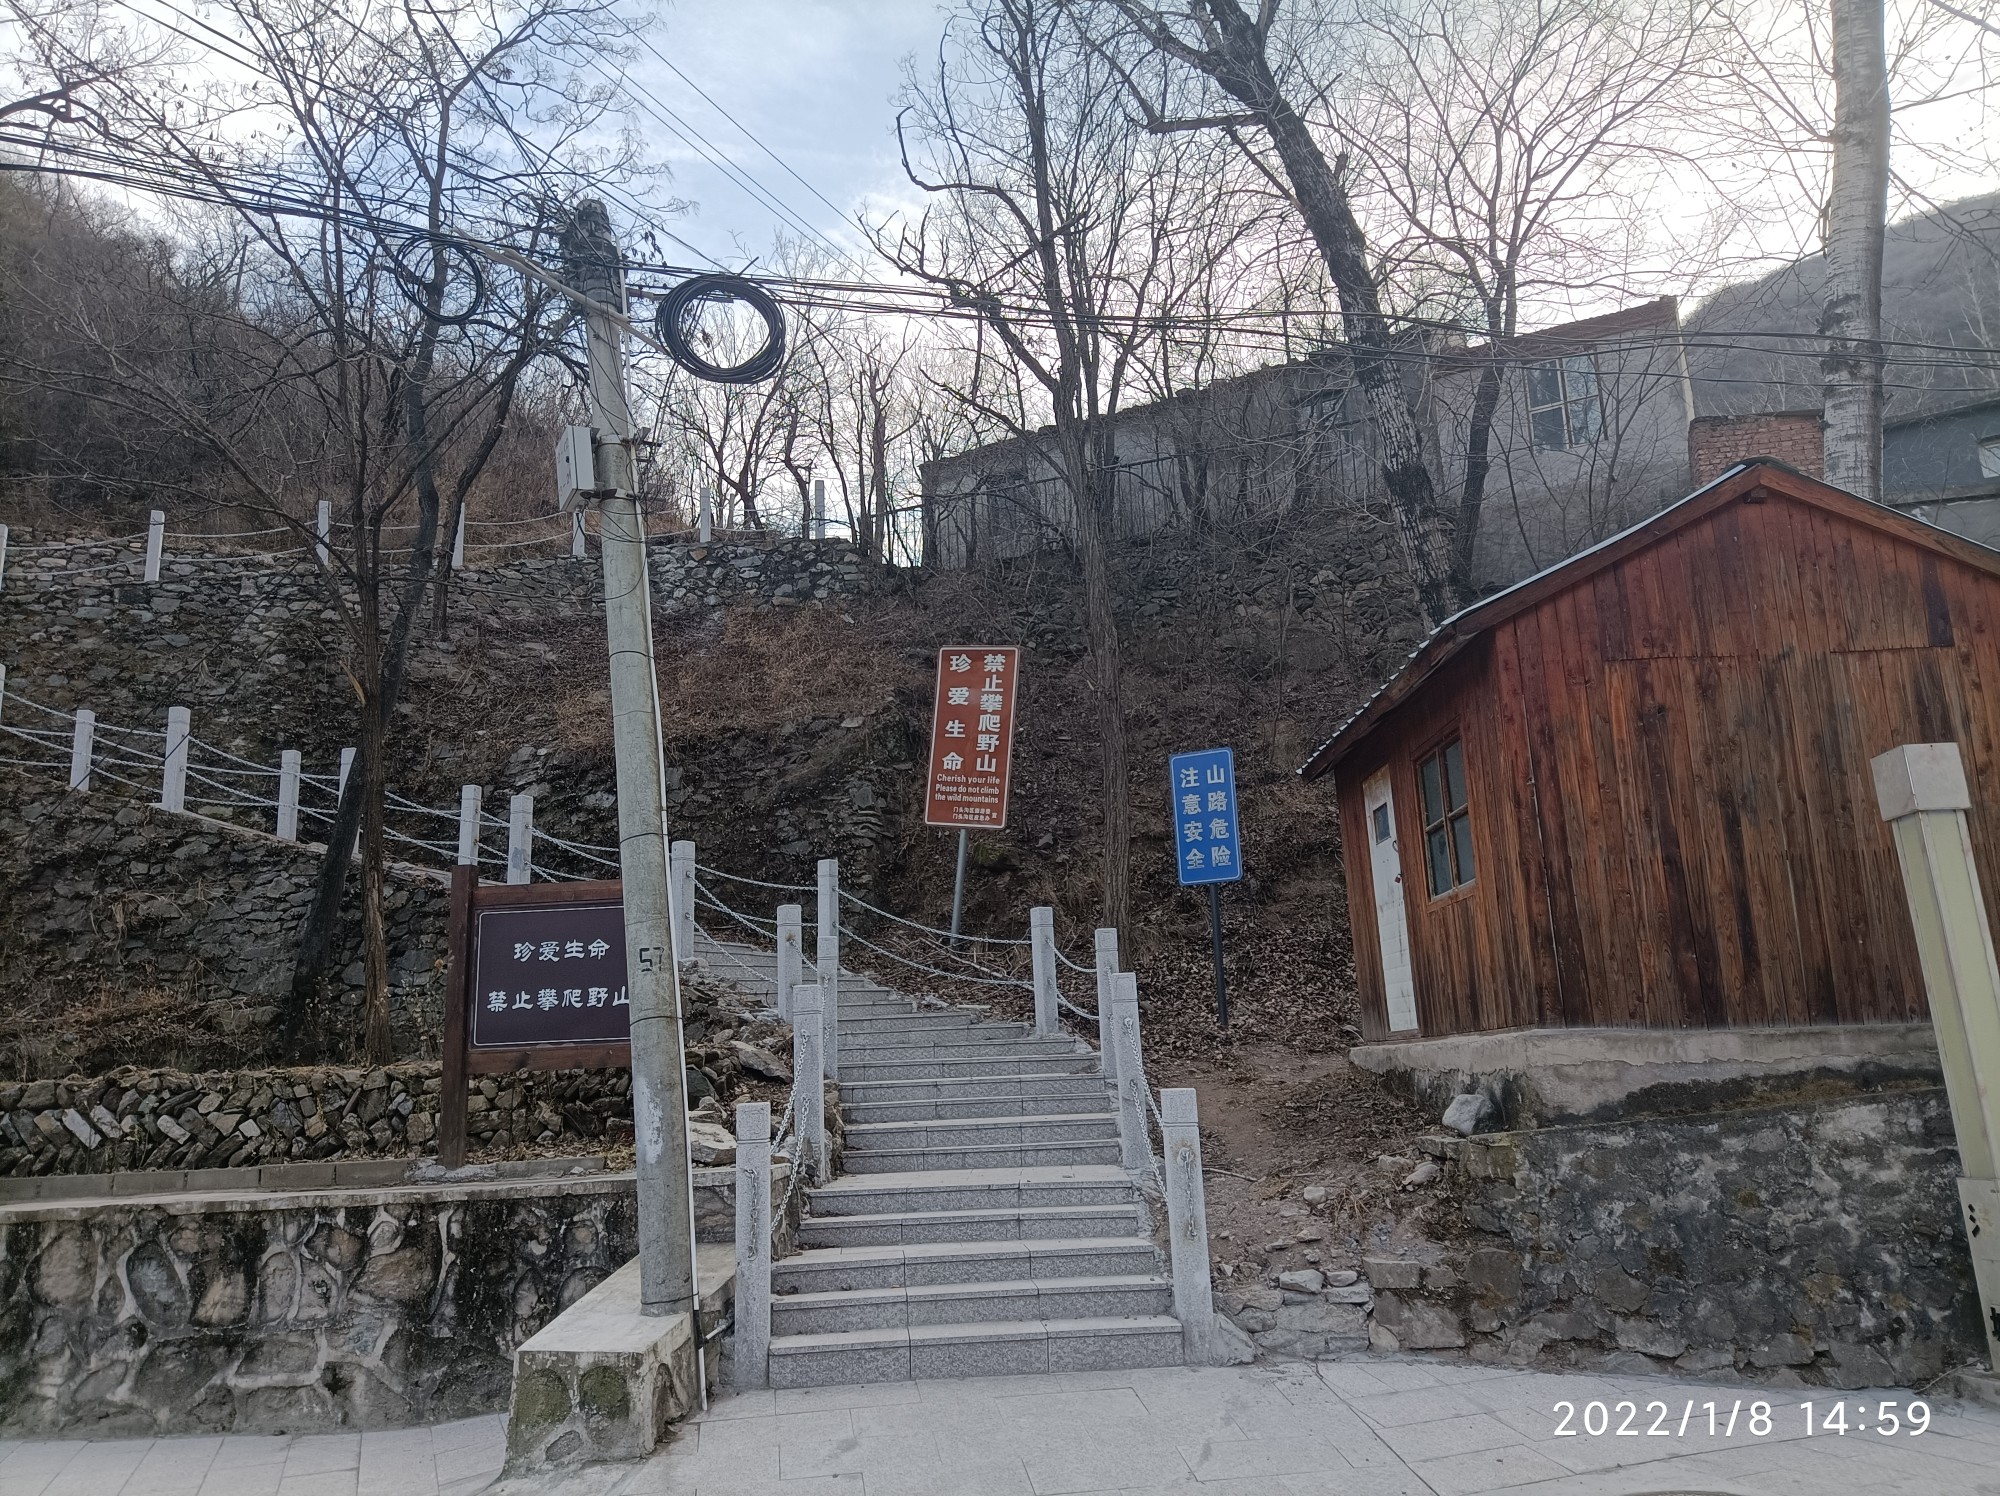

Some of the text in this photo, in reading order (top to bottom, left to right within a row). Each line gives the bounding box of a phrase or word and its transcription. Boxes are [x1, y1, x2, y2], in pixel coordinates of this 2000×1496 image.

[942, 653, 972, 771] 珍爱生命
[976, 653, 1006, 773] 禁止攀爬野山
[935, 783, 957, 792] Please
[958, 785, 967, 793] do
[980, 786, 1000, 795] climb
[937, 773, 1000, 784] Cherish your life
[935, 793, 999, 804] the wild mountains
[1180, 767, 1205, 869] 注意安全
[1207, 764, 1231, 867] 山路危险
[513, 938, 611, 963] 珍爱生命
[487, 985, 629, 1012] 禁止攀爬野山
